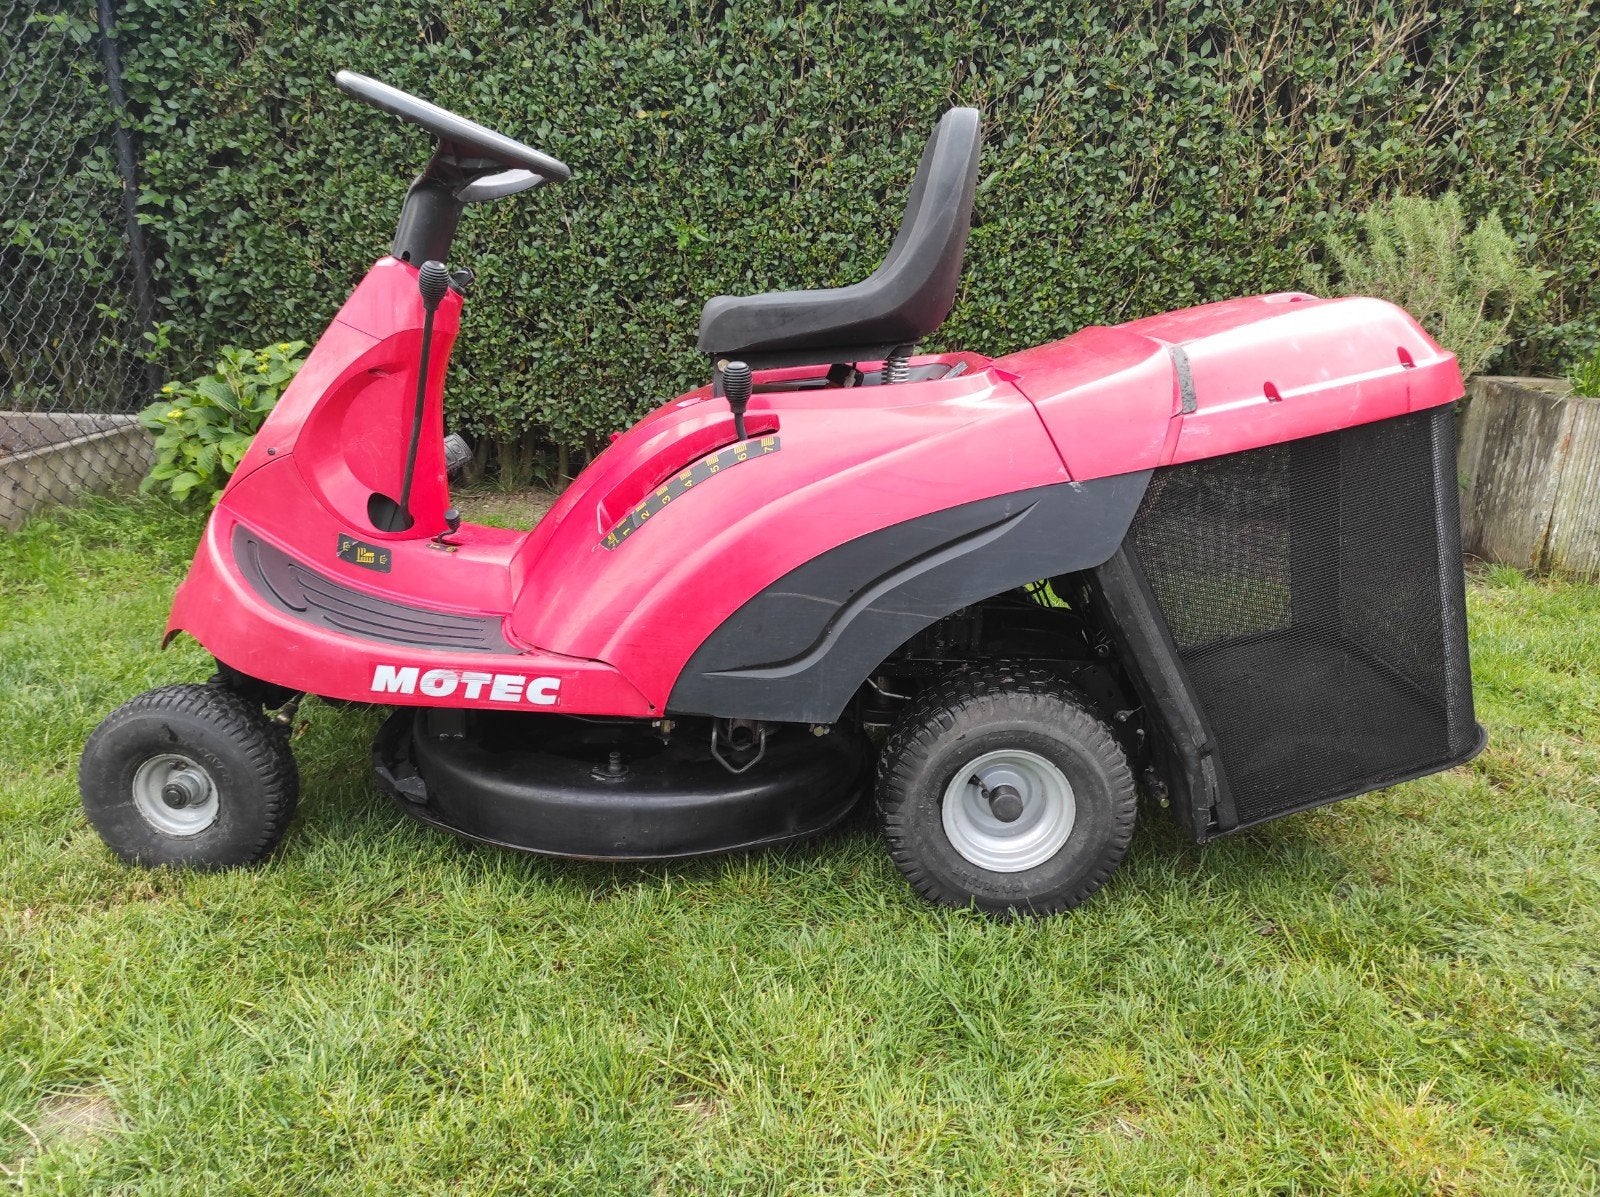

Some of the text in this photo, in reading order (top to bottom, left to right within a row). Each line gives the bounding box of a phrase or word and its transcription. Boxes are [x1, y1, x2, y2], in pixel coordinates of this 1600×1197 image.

[622, 445, 774, 536] 1 2 3 4 5 6 7
[370, 664, 561, 705] MOTEC
